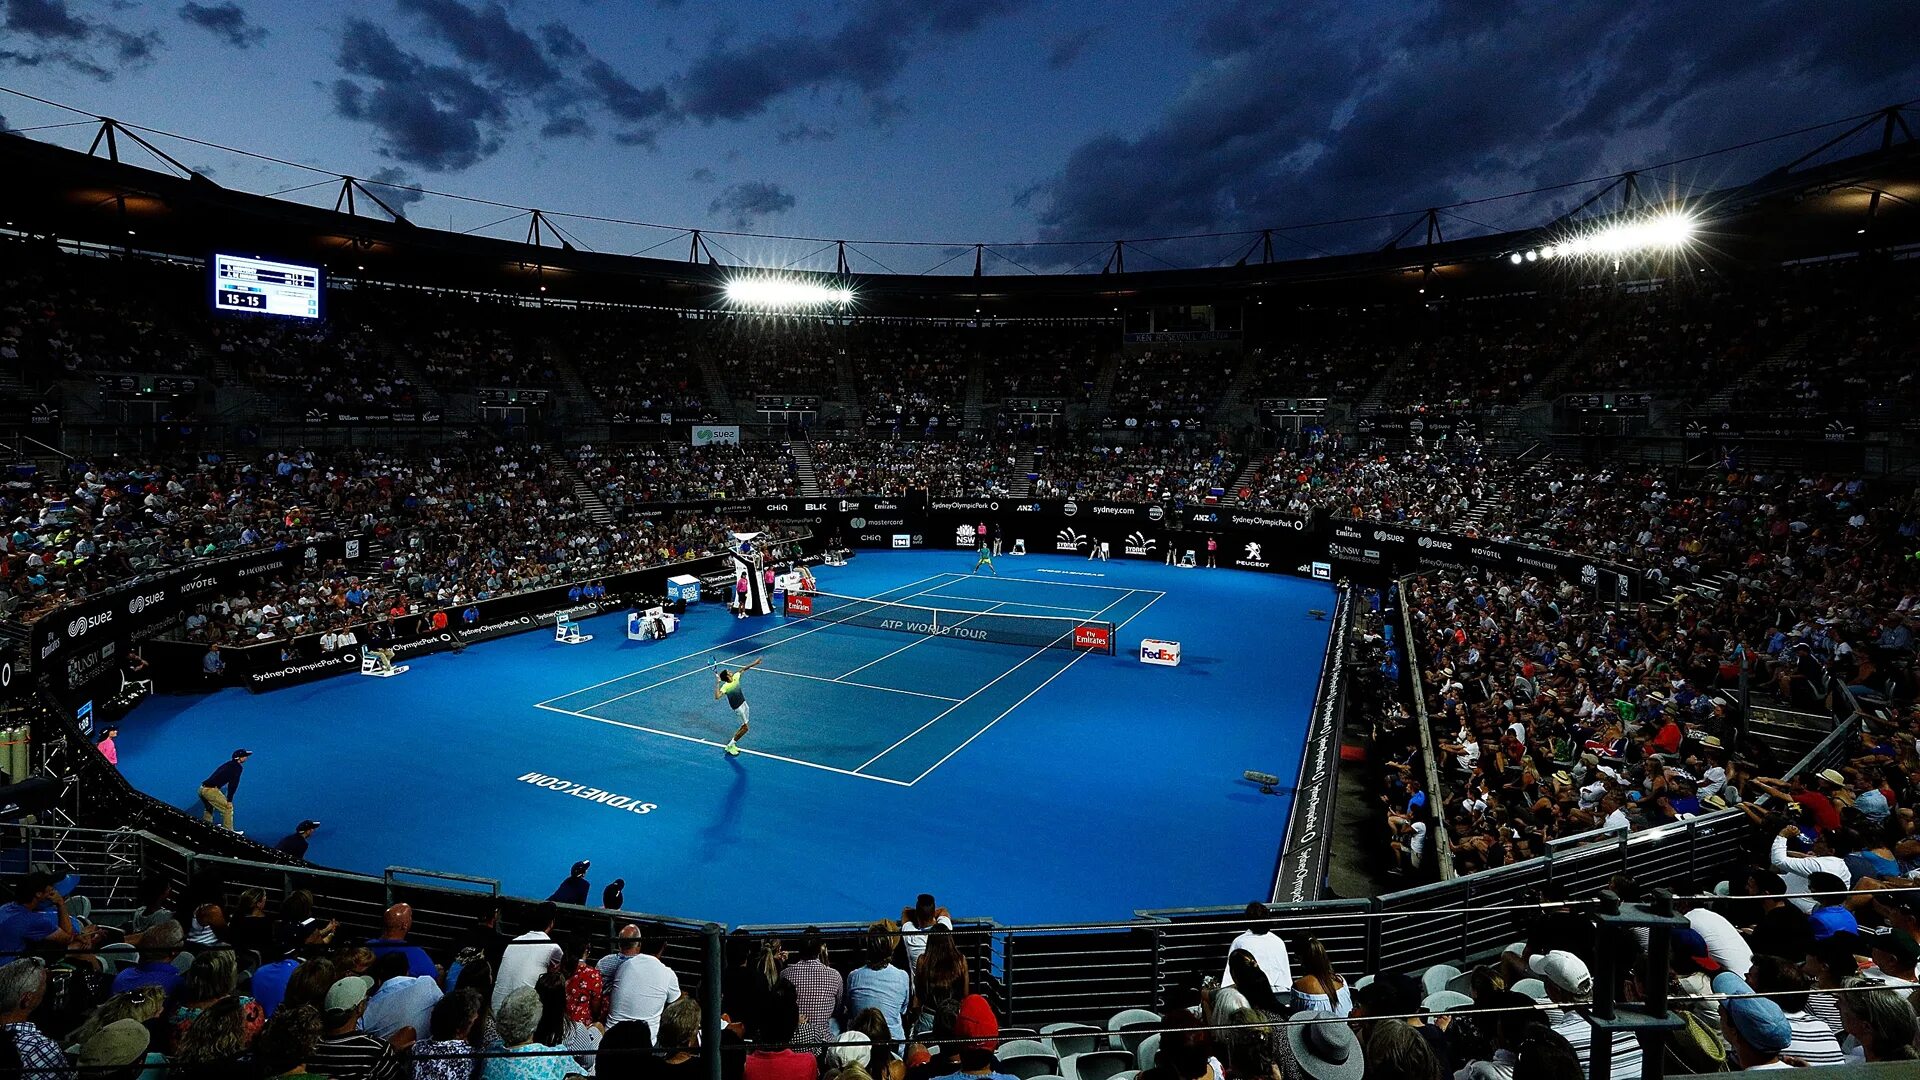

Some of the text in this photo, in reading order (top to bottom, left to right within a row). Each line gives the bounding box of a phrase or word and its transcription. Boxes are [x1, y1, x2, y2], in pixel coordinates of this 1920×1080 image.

[713, 430, 735, 438] suez
[805, 503, 828, 511] BLK
[932, 501, 989, 511] SydneyOlympicPark
[1016, 504, 1033, 512] ANZ
[1093, 505, 1135, 516] sydney.com
[1193, 513, 1211, 522] ANZ
[1232, 514, 1292, 528] SydneyOlympicPark
[956, 536, 975, 544] NSW
[1336, 530, 1362, 539] Emirates
[1386, 533, 1405, 543] suez
[1338, 545, 1361, 556] UNSW
[1432, 541, 1453, 551] suez
[1471, 547, 1503, 560] NOVOTEL
[1235, 559, 1270, 569] PEUGEOT
[180, 577, 219, 595] NOVOTEL
[144, 590, 165, 607] suez
[788, 602, 810, 613] Emirates
[87, 610, 114, 630] suez
[458, 618, 520, 638] SydneyOlympicPark
[879, 618, 989, 641] ATP WORLD TOUR
[1076, 634, 1107, 646] Emirates
[1086, 630, 1097, 639] Fly
[1141, 647, 1176, 663] FedEx
[252, 657, 342, 683] SydneyOlympicPark
[516, 771, 659, 815] SYDNEY.COM
[1305, 782, 1323, 833] SydneyOlympicPark
